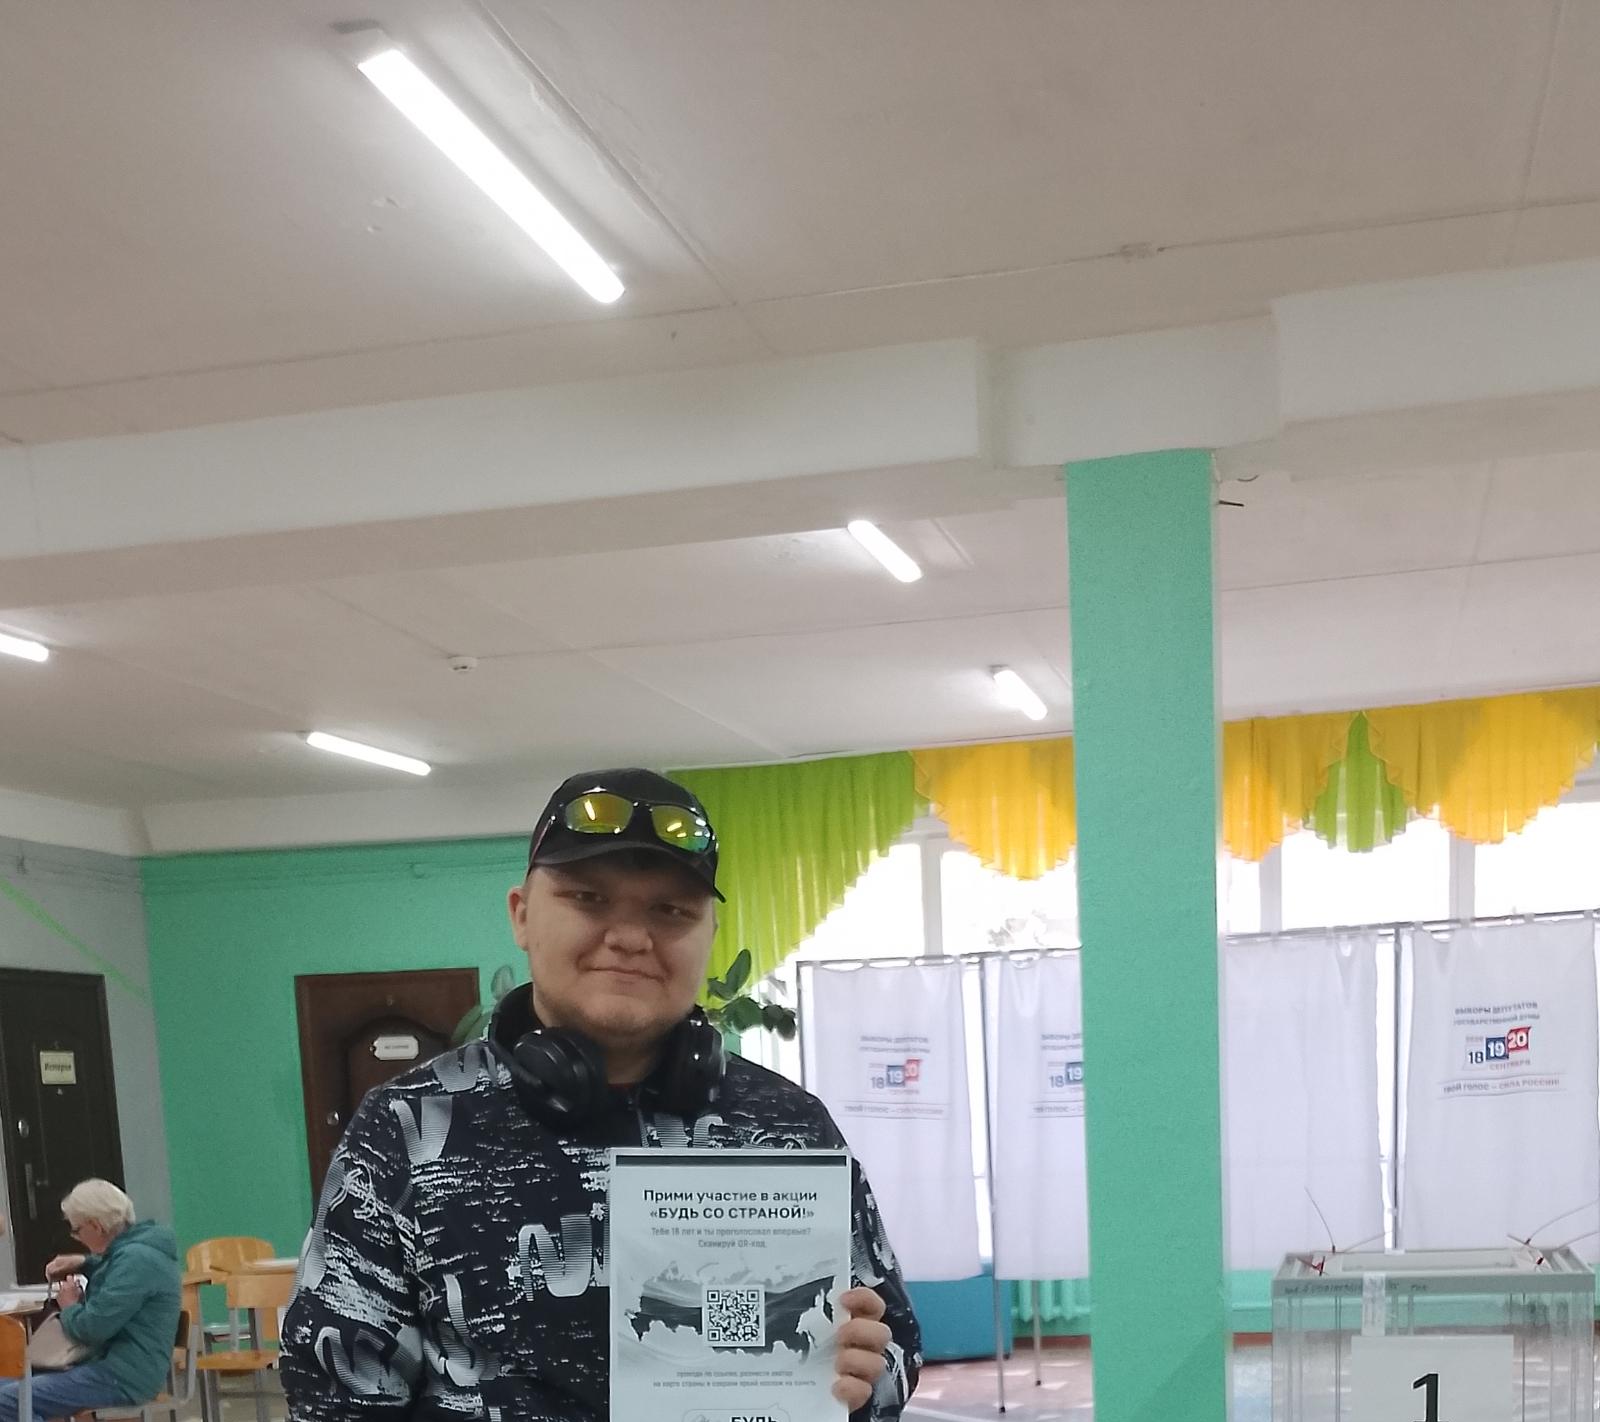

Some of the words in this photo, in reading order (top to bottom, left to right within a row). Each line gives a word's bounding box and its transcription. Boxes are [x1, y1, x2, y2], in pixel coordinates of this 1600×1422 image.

[1468, 1051, 1484, 1064] 18
[1487, 1042, 1505, 1058] 19
[1507, 1031, 1528, 1049] 20
[870, 1077, 885, 1089] 18
[1049, 1075, 1065, 1088] 18
[644, 1190, 693, 1204] Прими
[697, 1191, 757, 1204] участие
[761, 1191, 769, 1201] в
[772, 1191, 817, 1203] акции
[650, 1207, 699, 1220] «БУДЬ
[703, 1207, 725, 1219] СО
[728, 1204, 815, 1219] СТРАНОЙ!»
